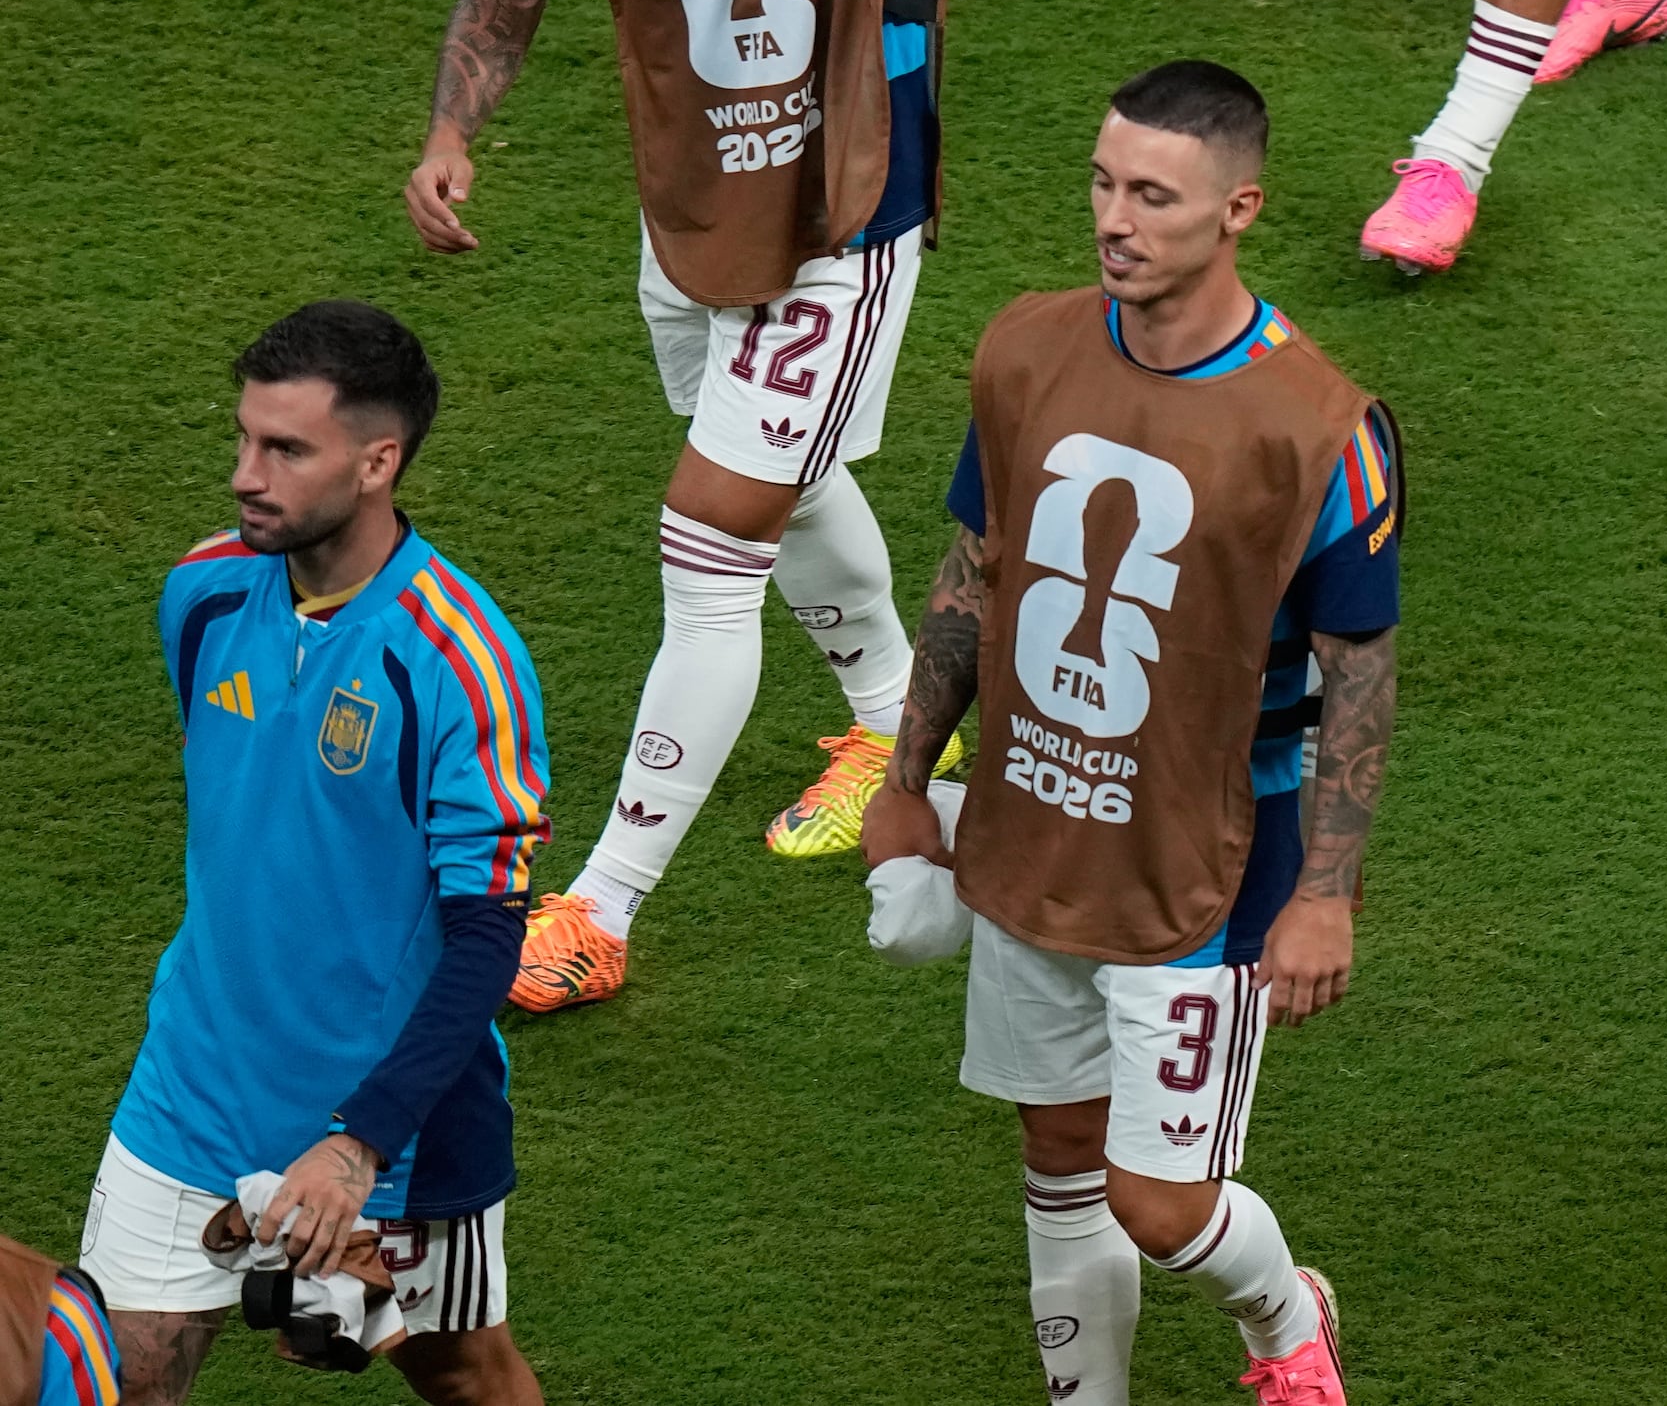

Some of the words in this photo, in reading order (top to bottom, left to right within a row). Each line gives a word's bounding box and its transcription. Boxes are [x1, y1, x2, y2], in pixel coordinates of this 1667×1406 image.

[728, 299, 833, 400] 12
[1004, 746, 1134, 824] 2026
[1010, 714, 1082, 768] WORLD
[1082, 750, 1138, 780] CUP
[1156, 991, 1220, 1094] 3
